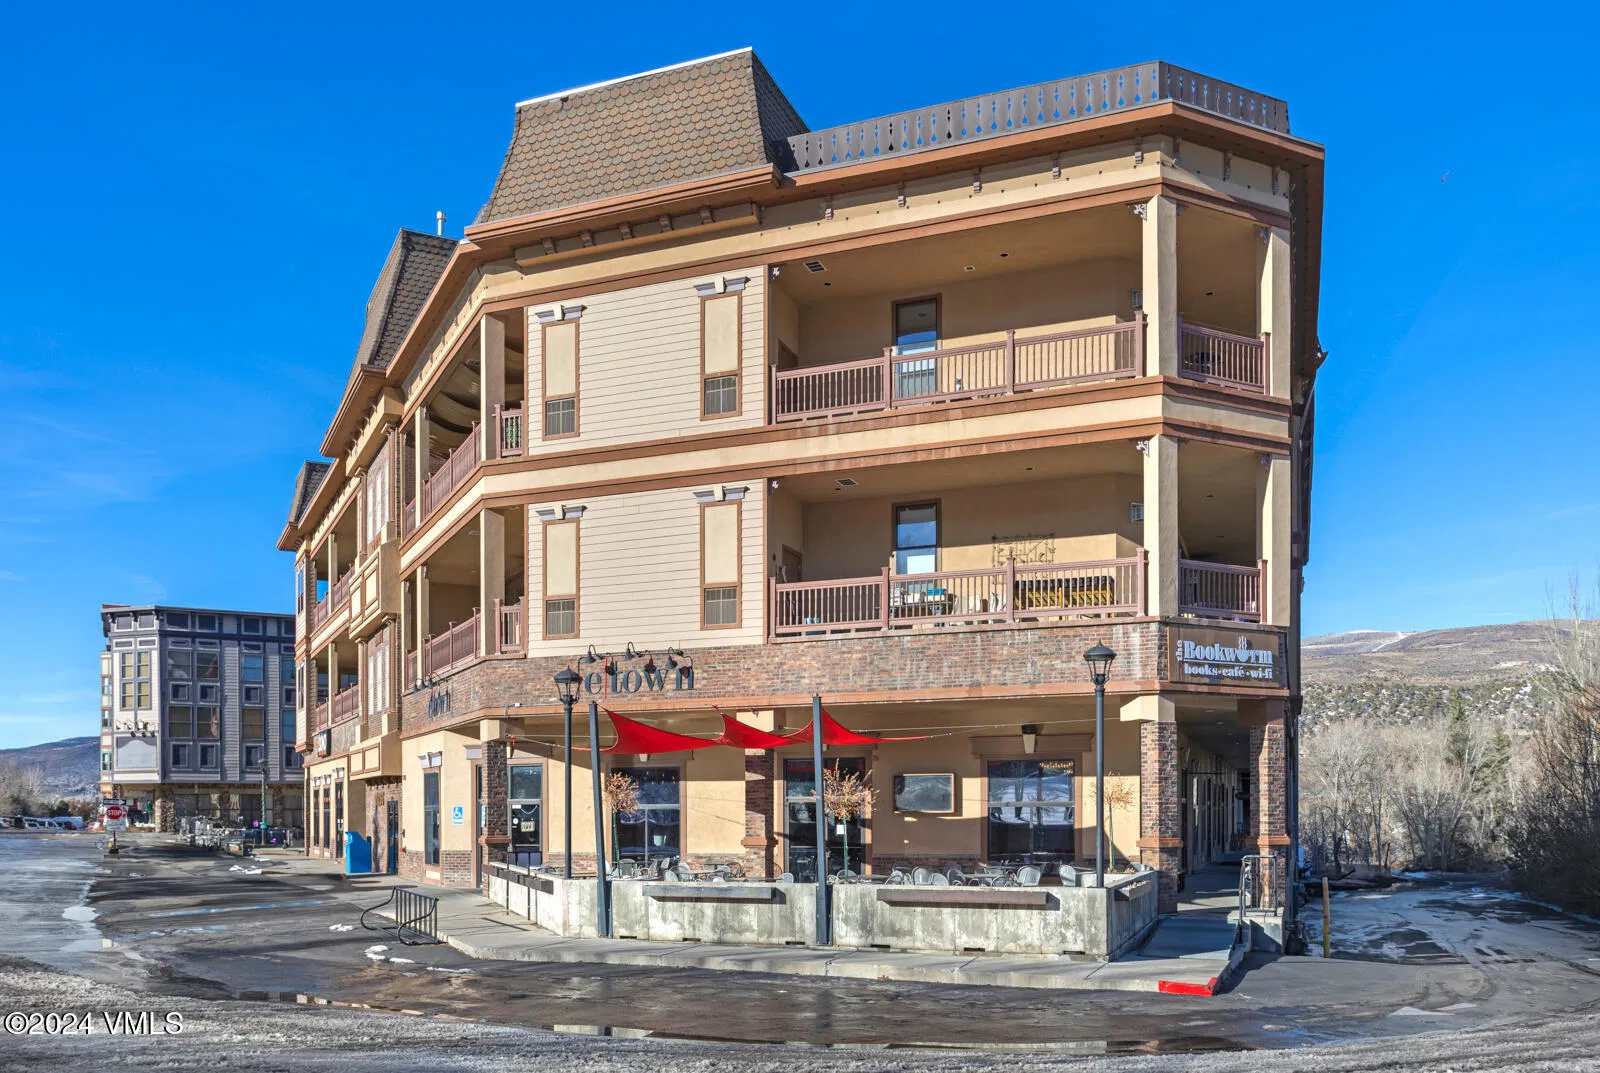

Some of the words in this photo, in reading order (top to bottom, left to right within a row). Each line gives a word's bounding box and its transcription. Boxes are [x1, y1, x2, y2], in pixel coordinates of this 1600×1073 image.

[584, 660, 697, 695] etown
[1184, 663, 1218, 676] books
[1222, 665, 1245, 678] café
[1250, 669, 1273, 679] wi-fi
